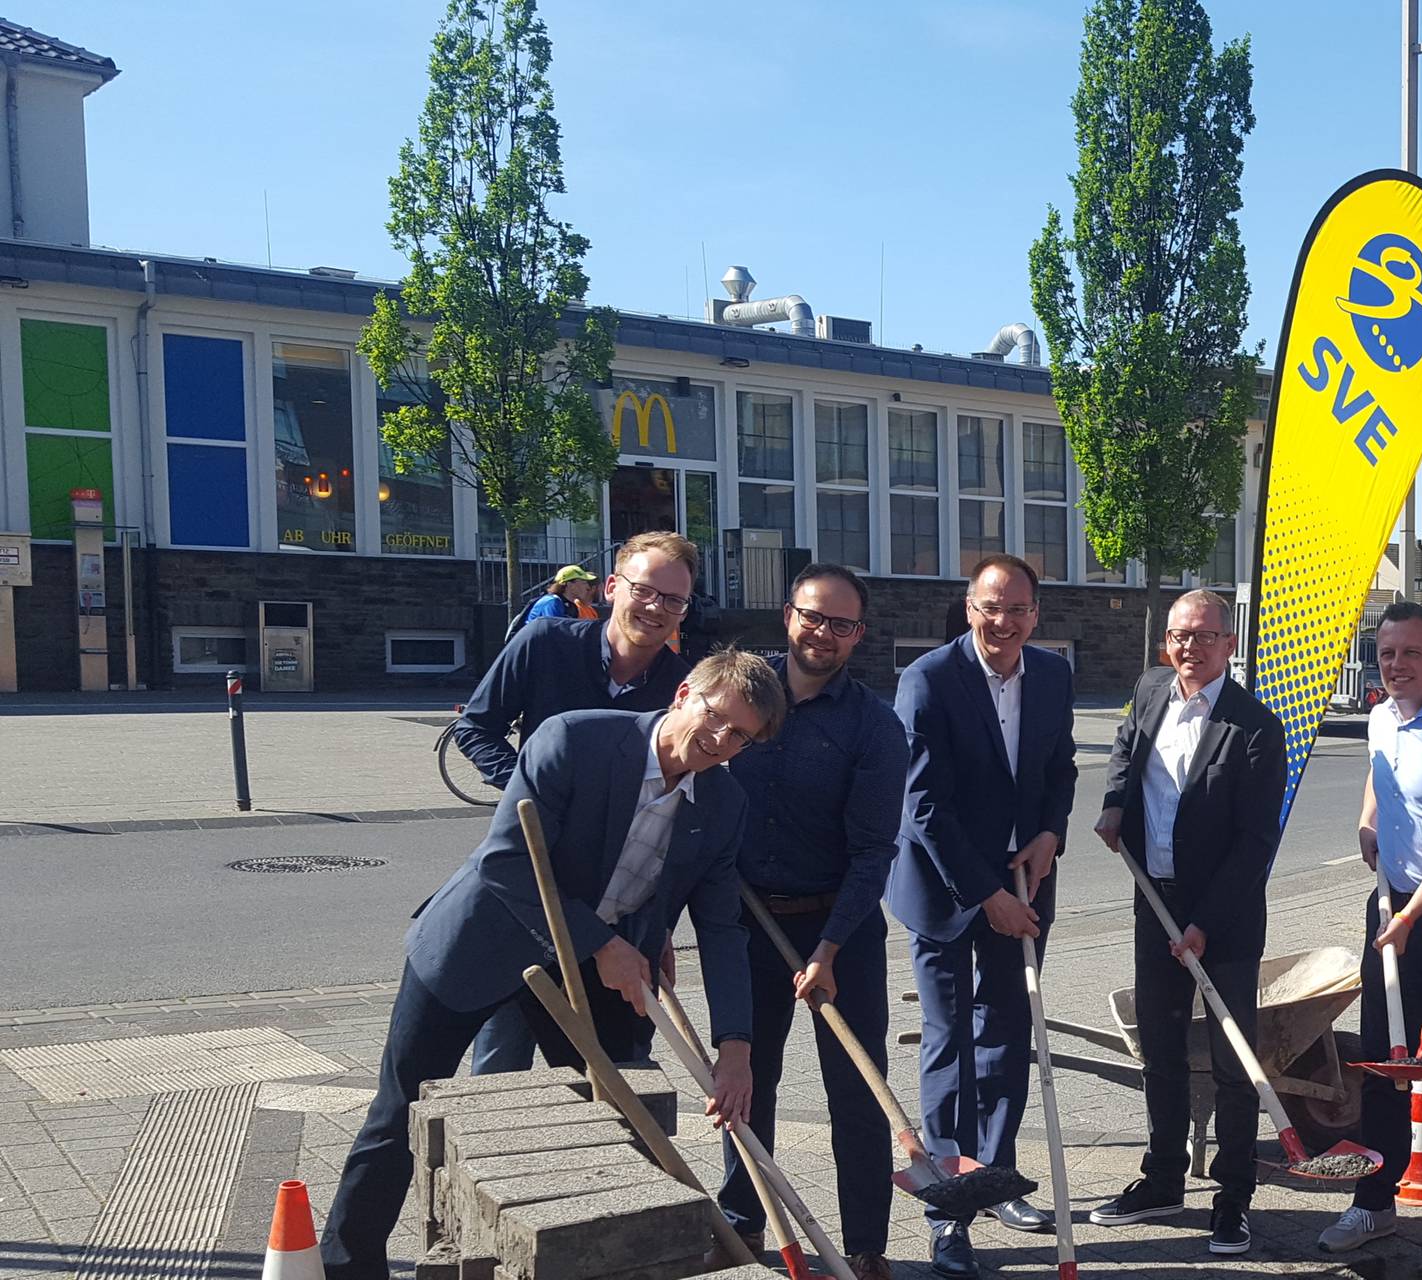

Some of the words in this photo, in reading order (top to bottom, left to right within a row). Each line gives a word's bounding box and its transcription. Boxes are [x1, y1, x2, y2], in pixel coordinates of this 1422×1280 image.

[1297, 336, 1398, 467] SVE
[284, 529, 304, 542] AB
[321, 531, 351, 544] UHR
[386, 532, 449, 548] GEÖFFNET
